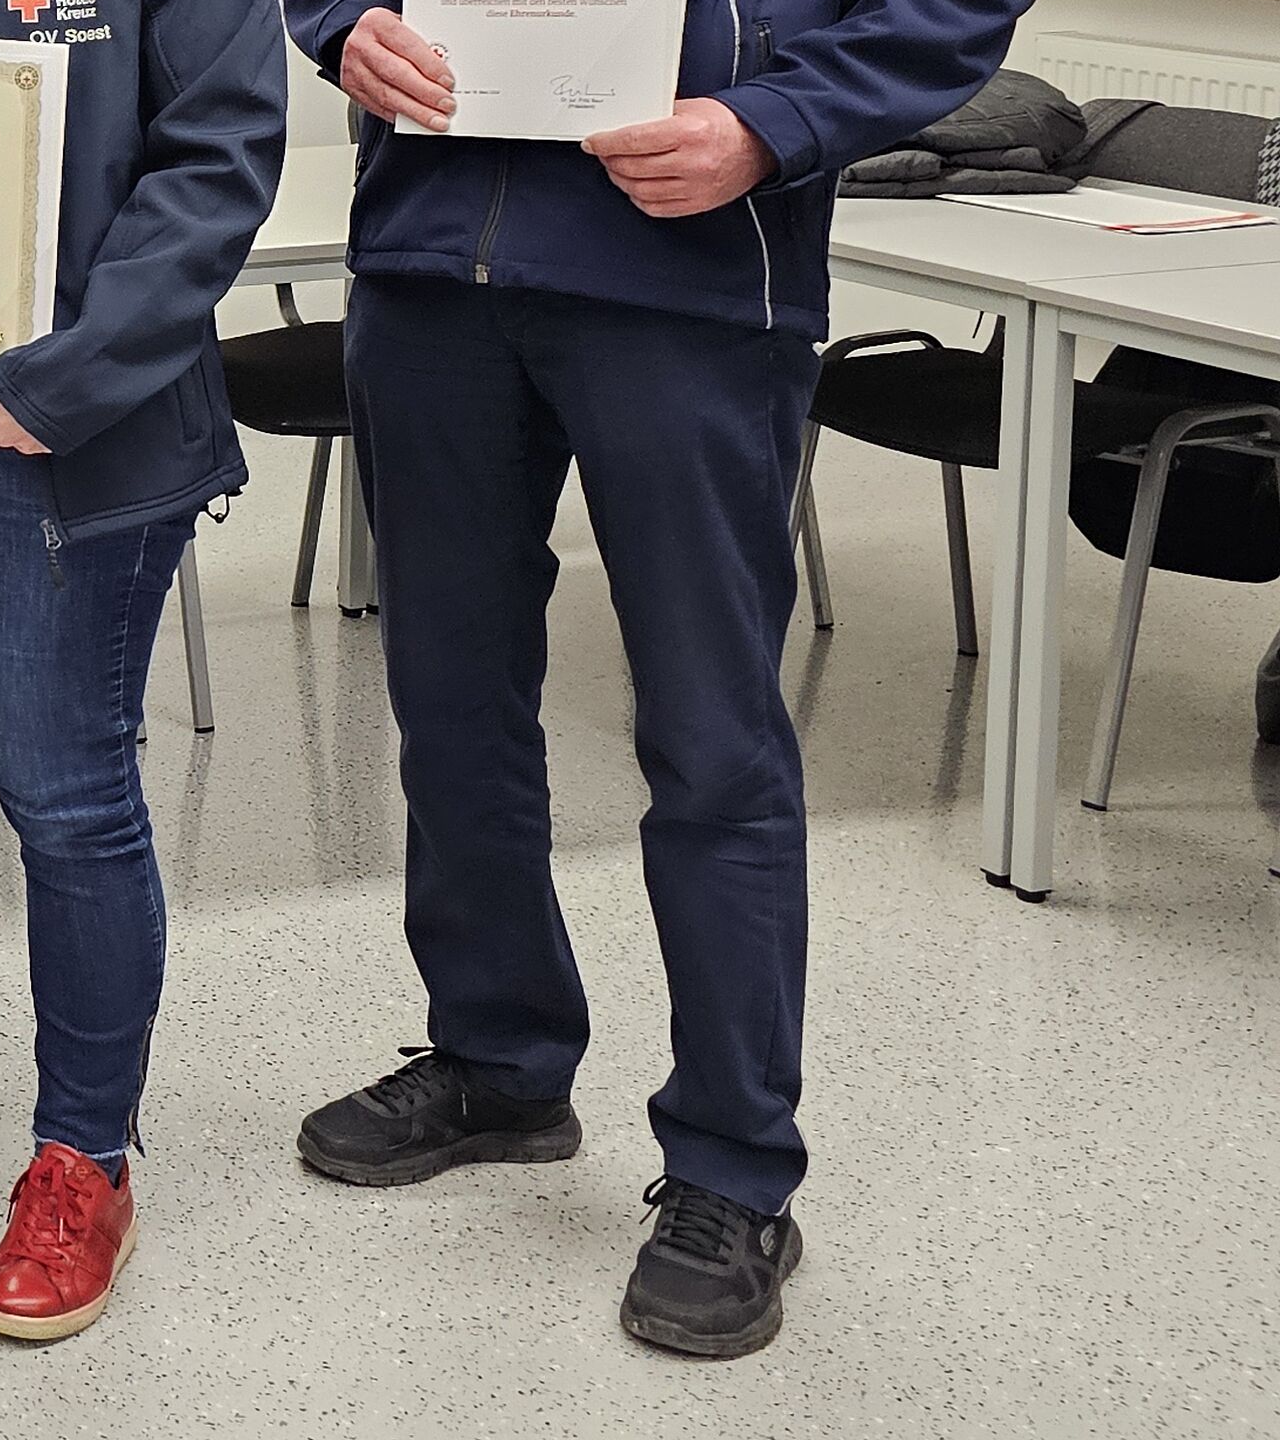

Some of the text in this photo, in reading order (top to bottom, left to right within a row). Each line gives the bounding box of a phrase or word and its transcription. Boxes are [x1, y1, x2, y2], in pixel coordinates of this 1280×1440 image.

[57, 7, 96, 20] Kreuz
[30, 25, 111, 43] OV Soest
